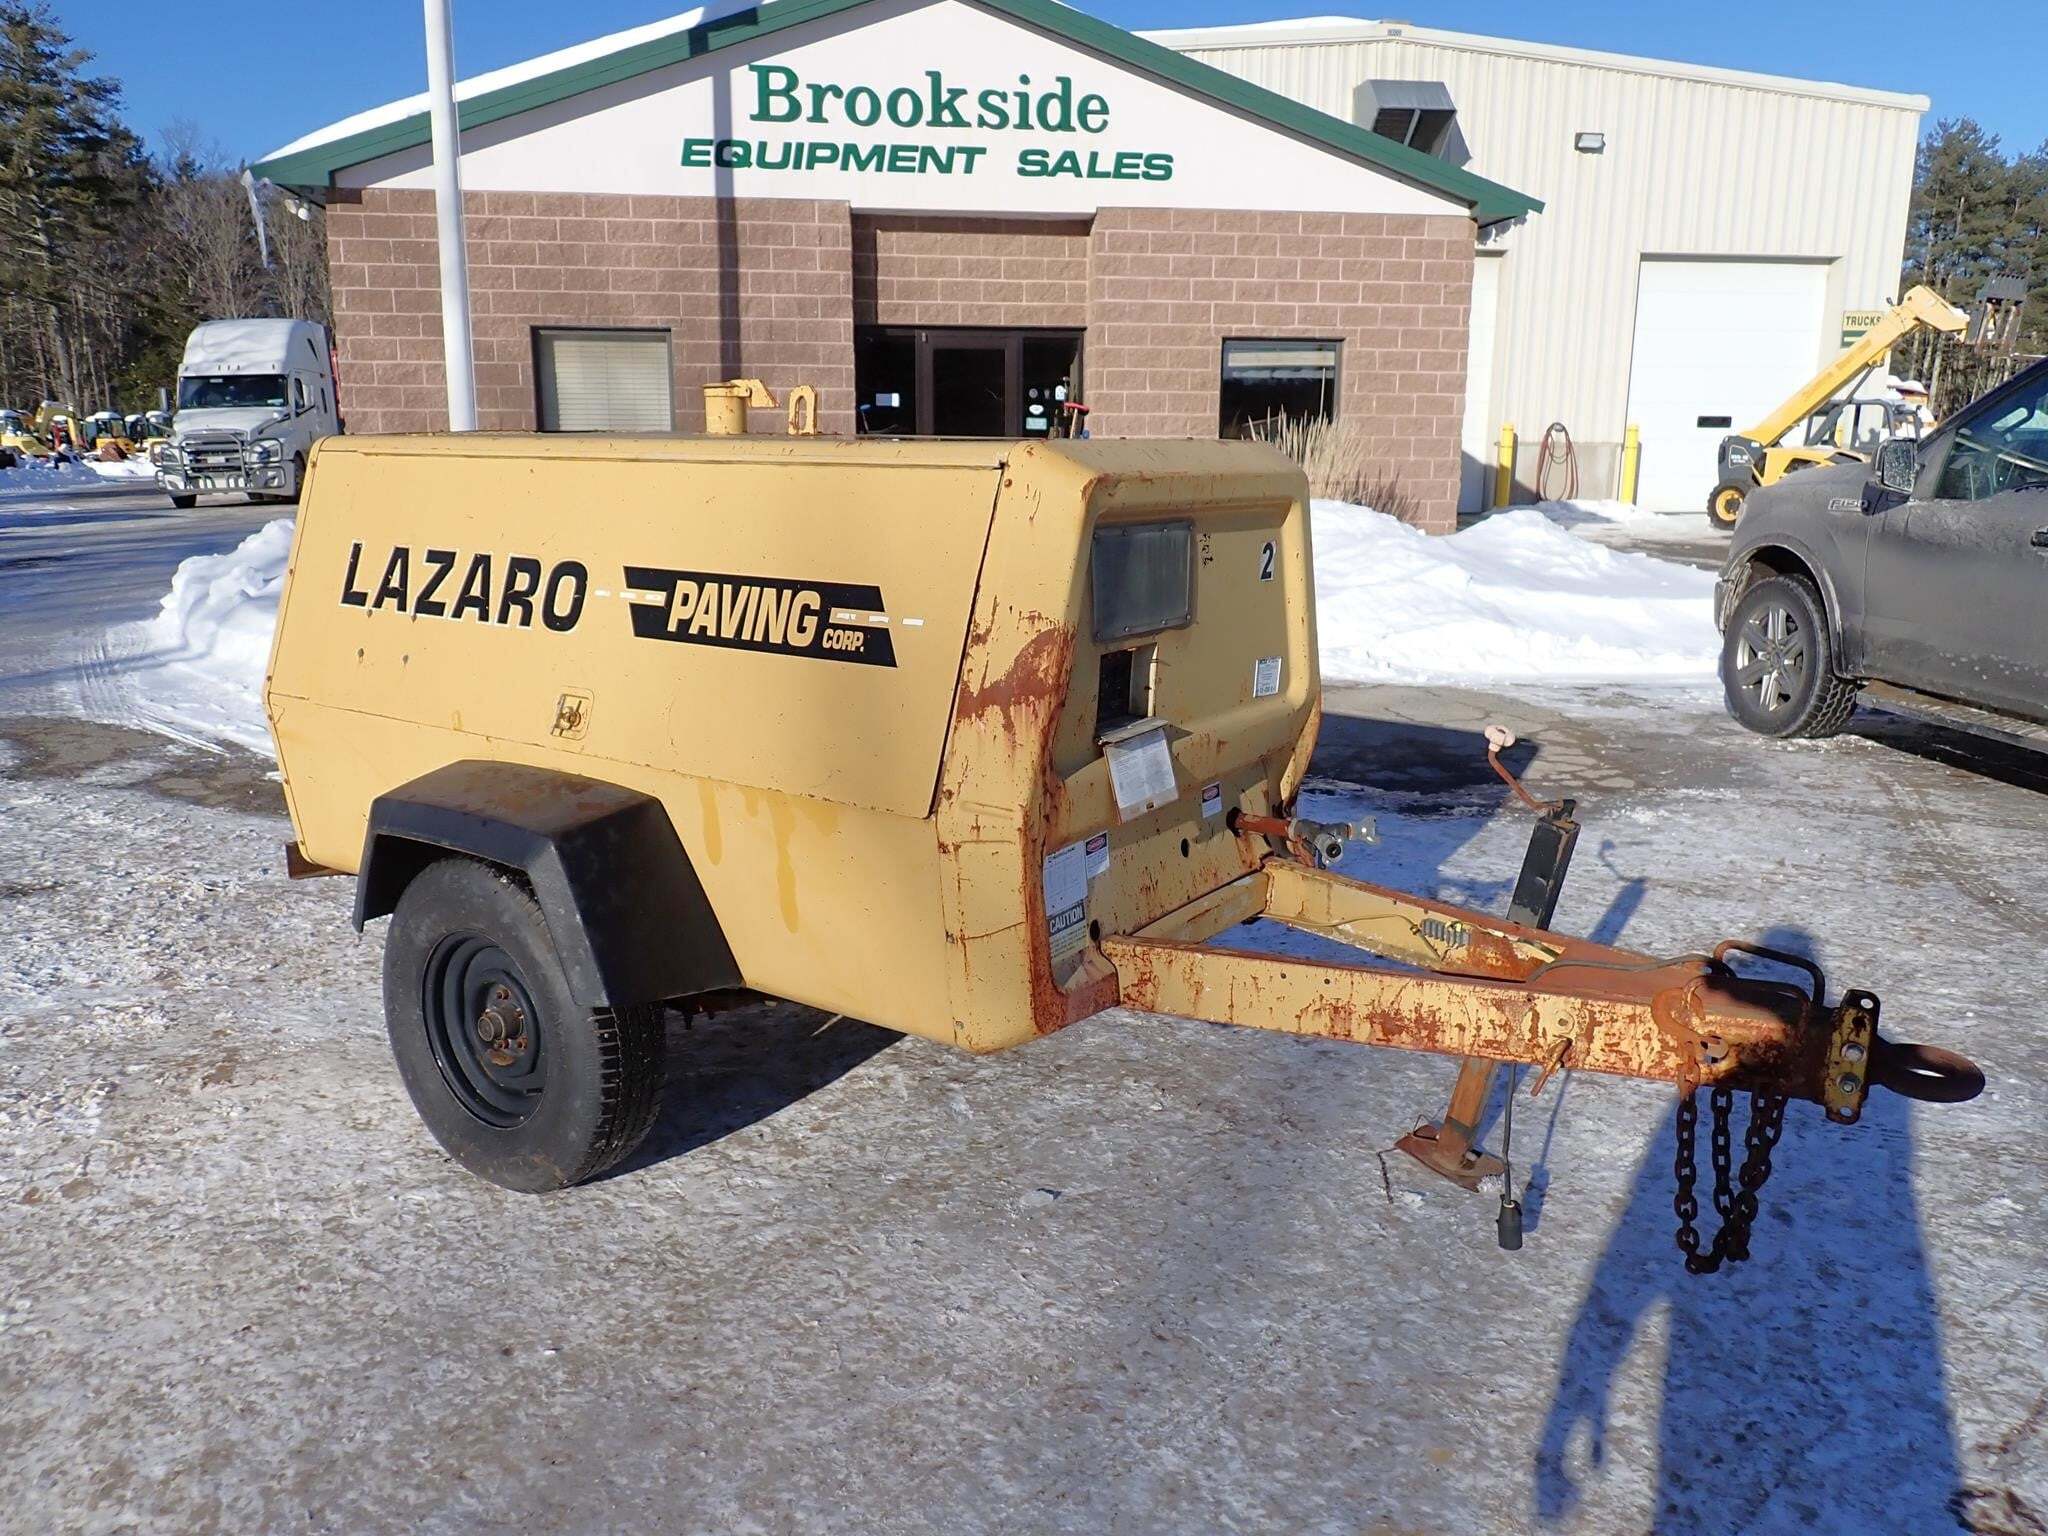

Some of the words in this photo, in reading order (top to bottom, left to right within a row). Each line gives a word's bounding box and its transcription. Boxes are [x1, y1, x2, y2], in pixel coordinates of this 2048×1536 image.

[748, 64, 1110, 133] Brookside
[681, 138, 987, 174] EQUIPMENT
[1017, 149, 1174, 182] SALES
[1260, 542, 1274, 580] 2
[341, 541, 589, 633] LAZARO
[667, 581, 821, 647] PAVING
[822, 628, 865, 652] CORP.
[1049, 905, 1084, 934] CAUTION
